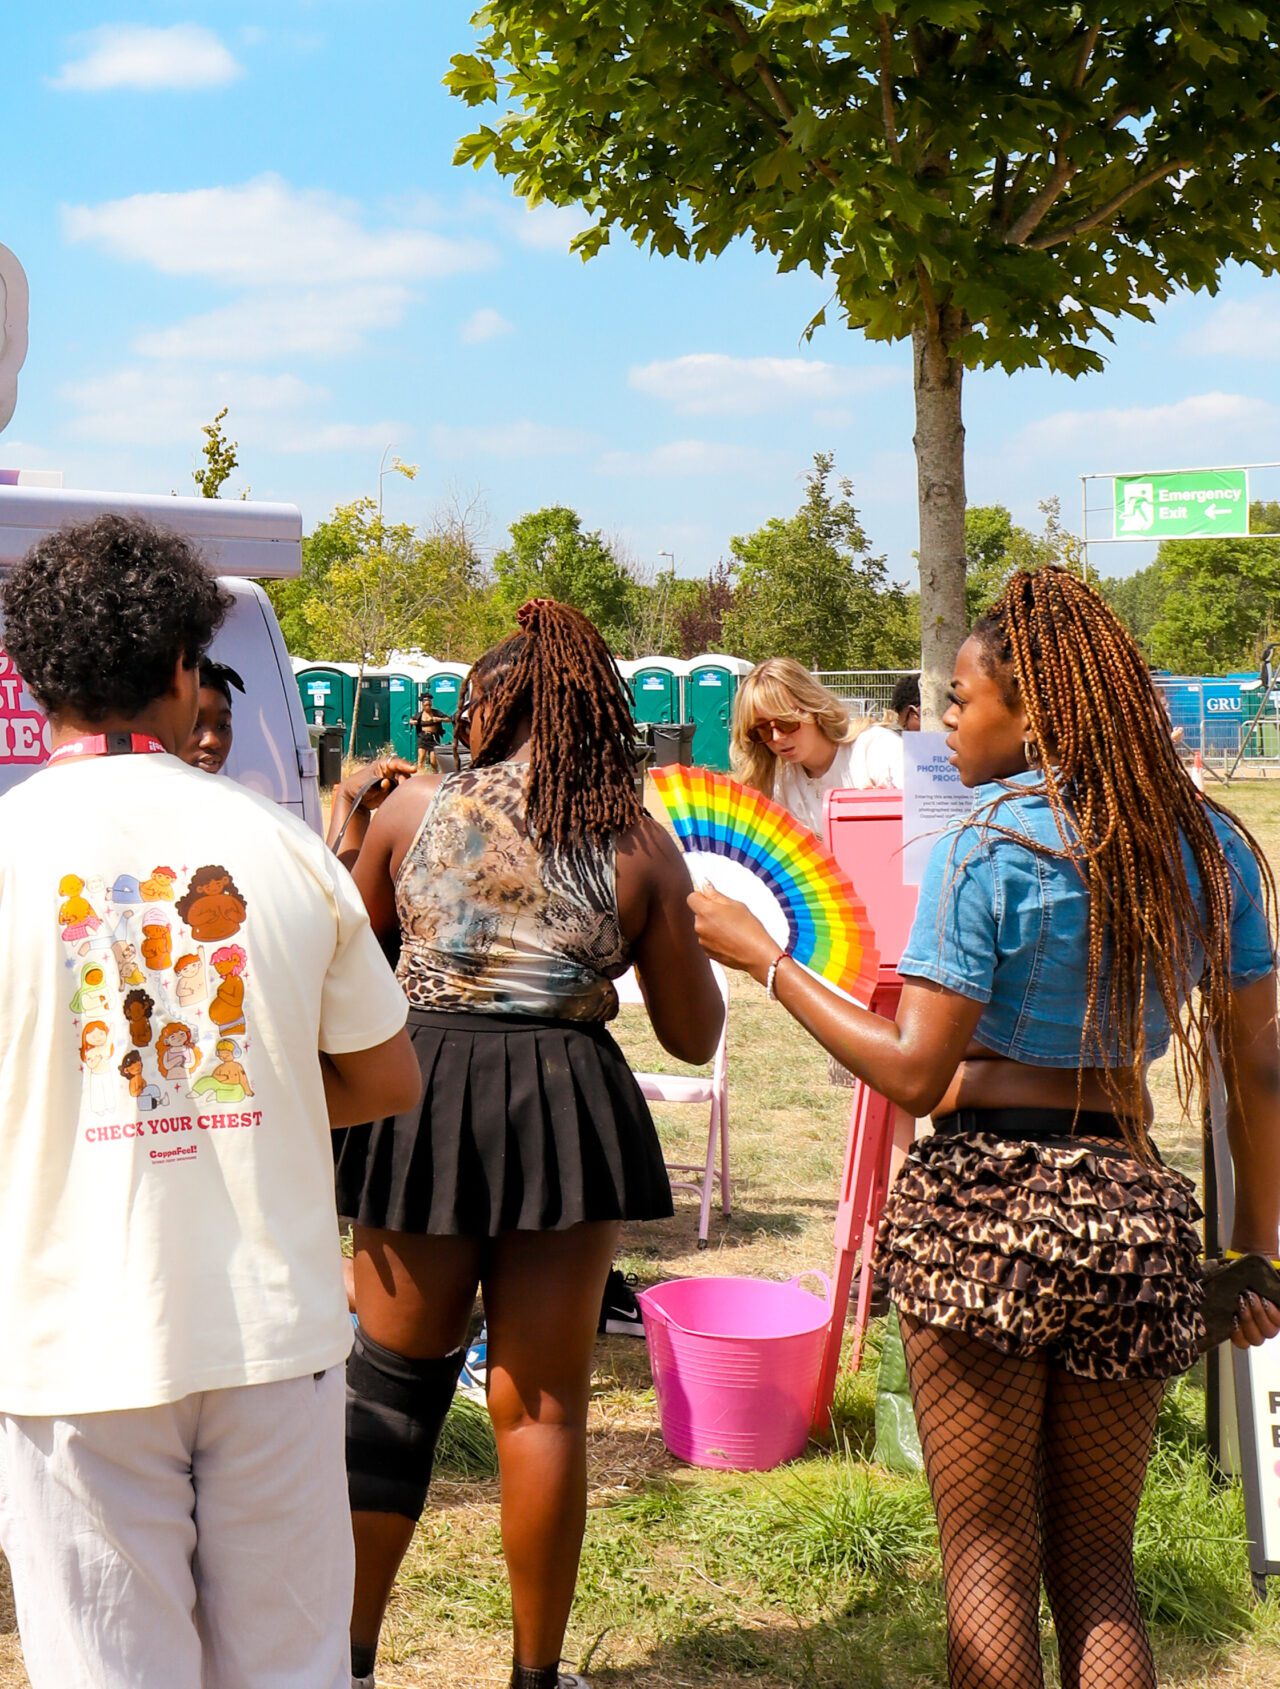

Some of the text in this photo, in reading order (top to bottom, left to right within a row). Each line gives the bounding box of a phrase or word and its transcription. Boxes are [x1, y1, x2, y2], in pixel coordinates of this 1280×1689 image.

[1158, 488, 1241, 503] Emergency
[1159, 506, 1187, 519] Exit
[85, 1111, 263, 1143] CHECK YOUR CHEST
